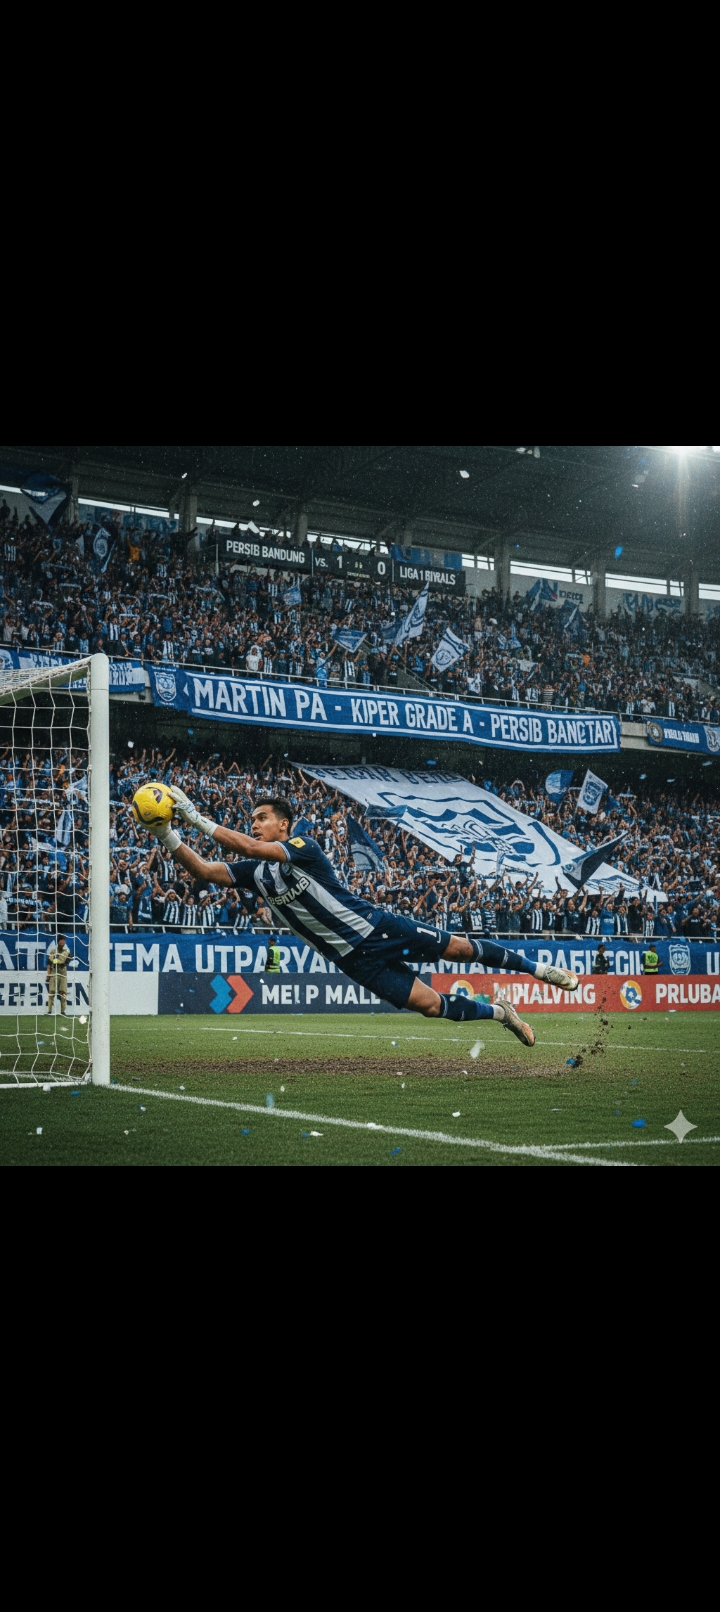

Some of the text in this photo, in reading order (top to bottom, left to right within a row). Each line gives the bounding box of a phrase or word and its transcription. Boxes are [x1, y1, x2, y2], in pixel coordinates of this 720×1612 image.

[226, 540, 306, 564] PERSIB BANDUNG
[336, 555, 343, 569] 1
[377, 561, 386, 575] 0
[399, 565, 419, 580] LIGA
[192, 677, 287, 718] MARTIN
[294, 689, 328, 721] PA
[350, 698, 400, 726] KIPER
[404, 702, 458, 732] GRADE
[462, 709, 475, 734] A
[489, 713, 543, 743] PERSIB
